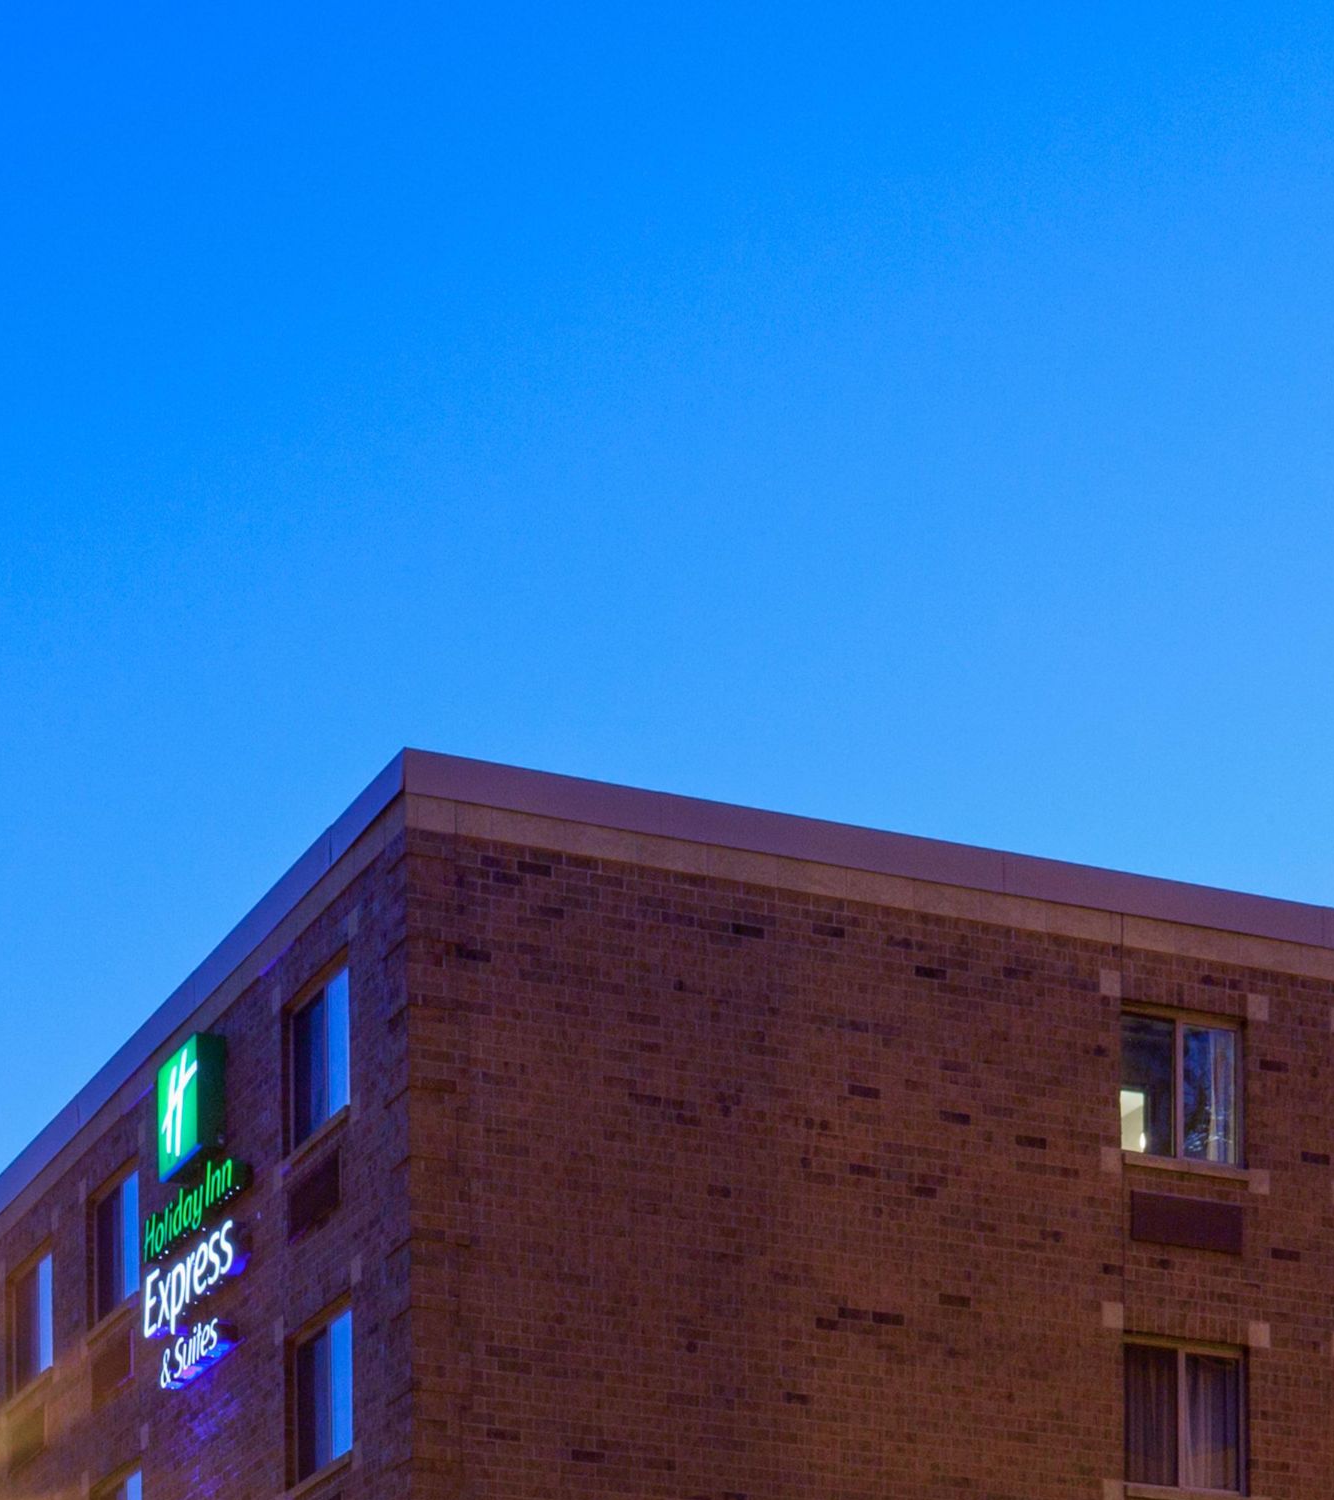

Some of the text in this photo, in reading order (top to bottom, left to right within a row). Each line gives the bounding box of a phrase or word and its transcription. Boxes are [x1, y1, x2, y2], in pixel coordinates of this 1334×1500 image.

[144, 1158, 233, 1262] Holiday Inn
[143, 1220, 234, 1339] Express
[160, 1318, 218, 1389] & Suites
